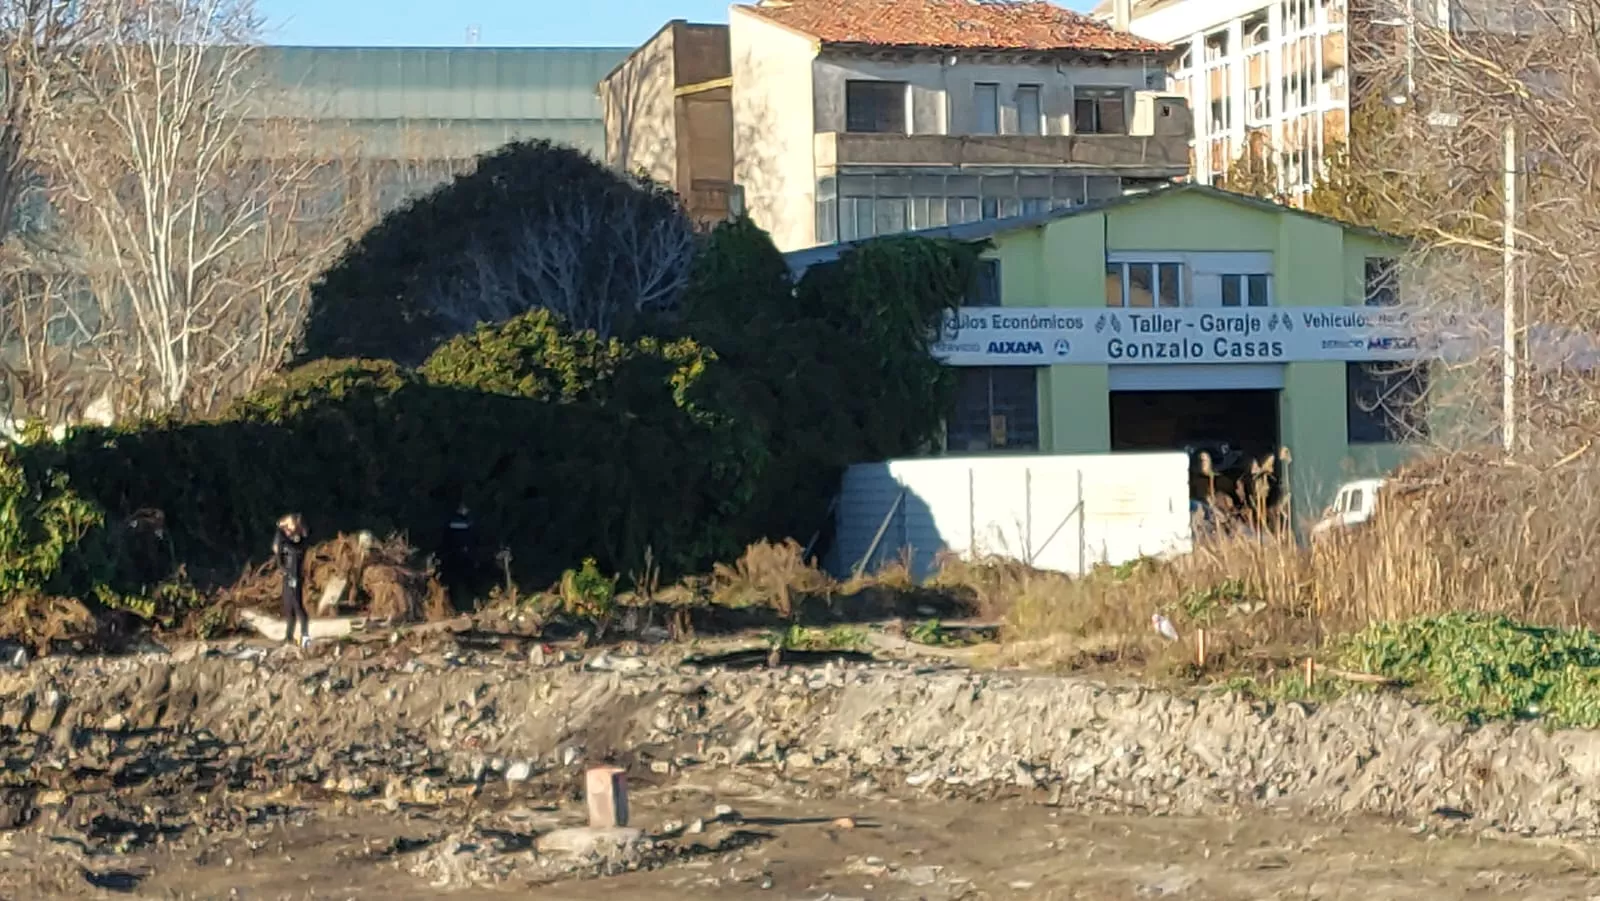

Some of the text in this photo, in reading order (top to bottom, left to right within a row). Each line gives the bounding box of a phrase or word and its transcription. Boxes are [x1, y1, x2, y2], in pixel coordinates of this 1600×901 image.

[992, 313, 1084, 329] Económicos
[1128, 314, 1181, 333] Taller
[1199, 313, 1261, 337] Garaje
[986, 341, 1044, 354] AIXAM
[1107, 337, 1283, 359] Gonzalo Casas
